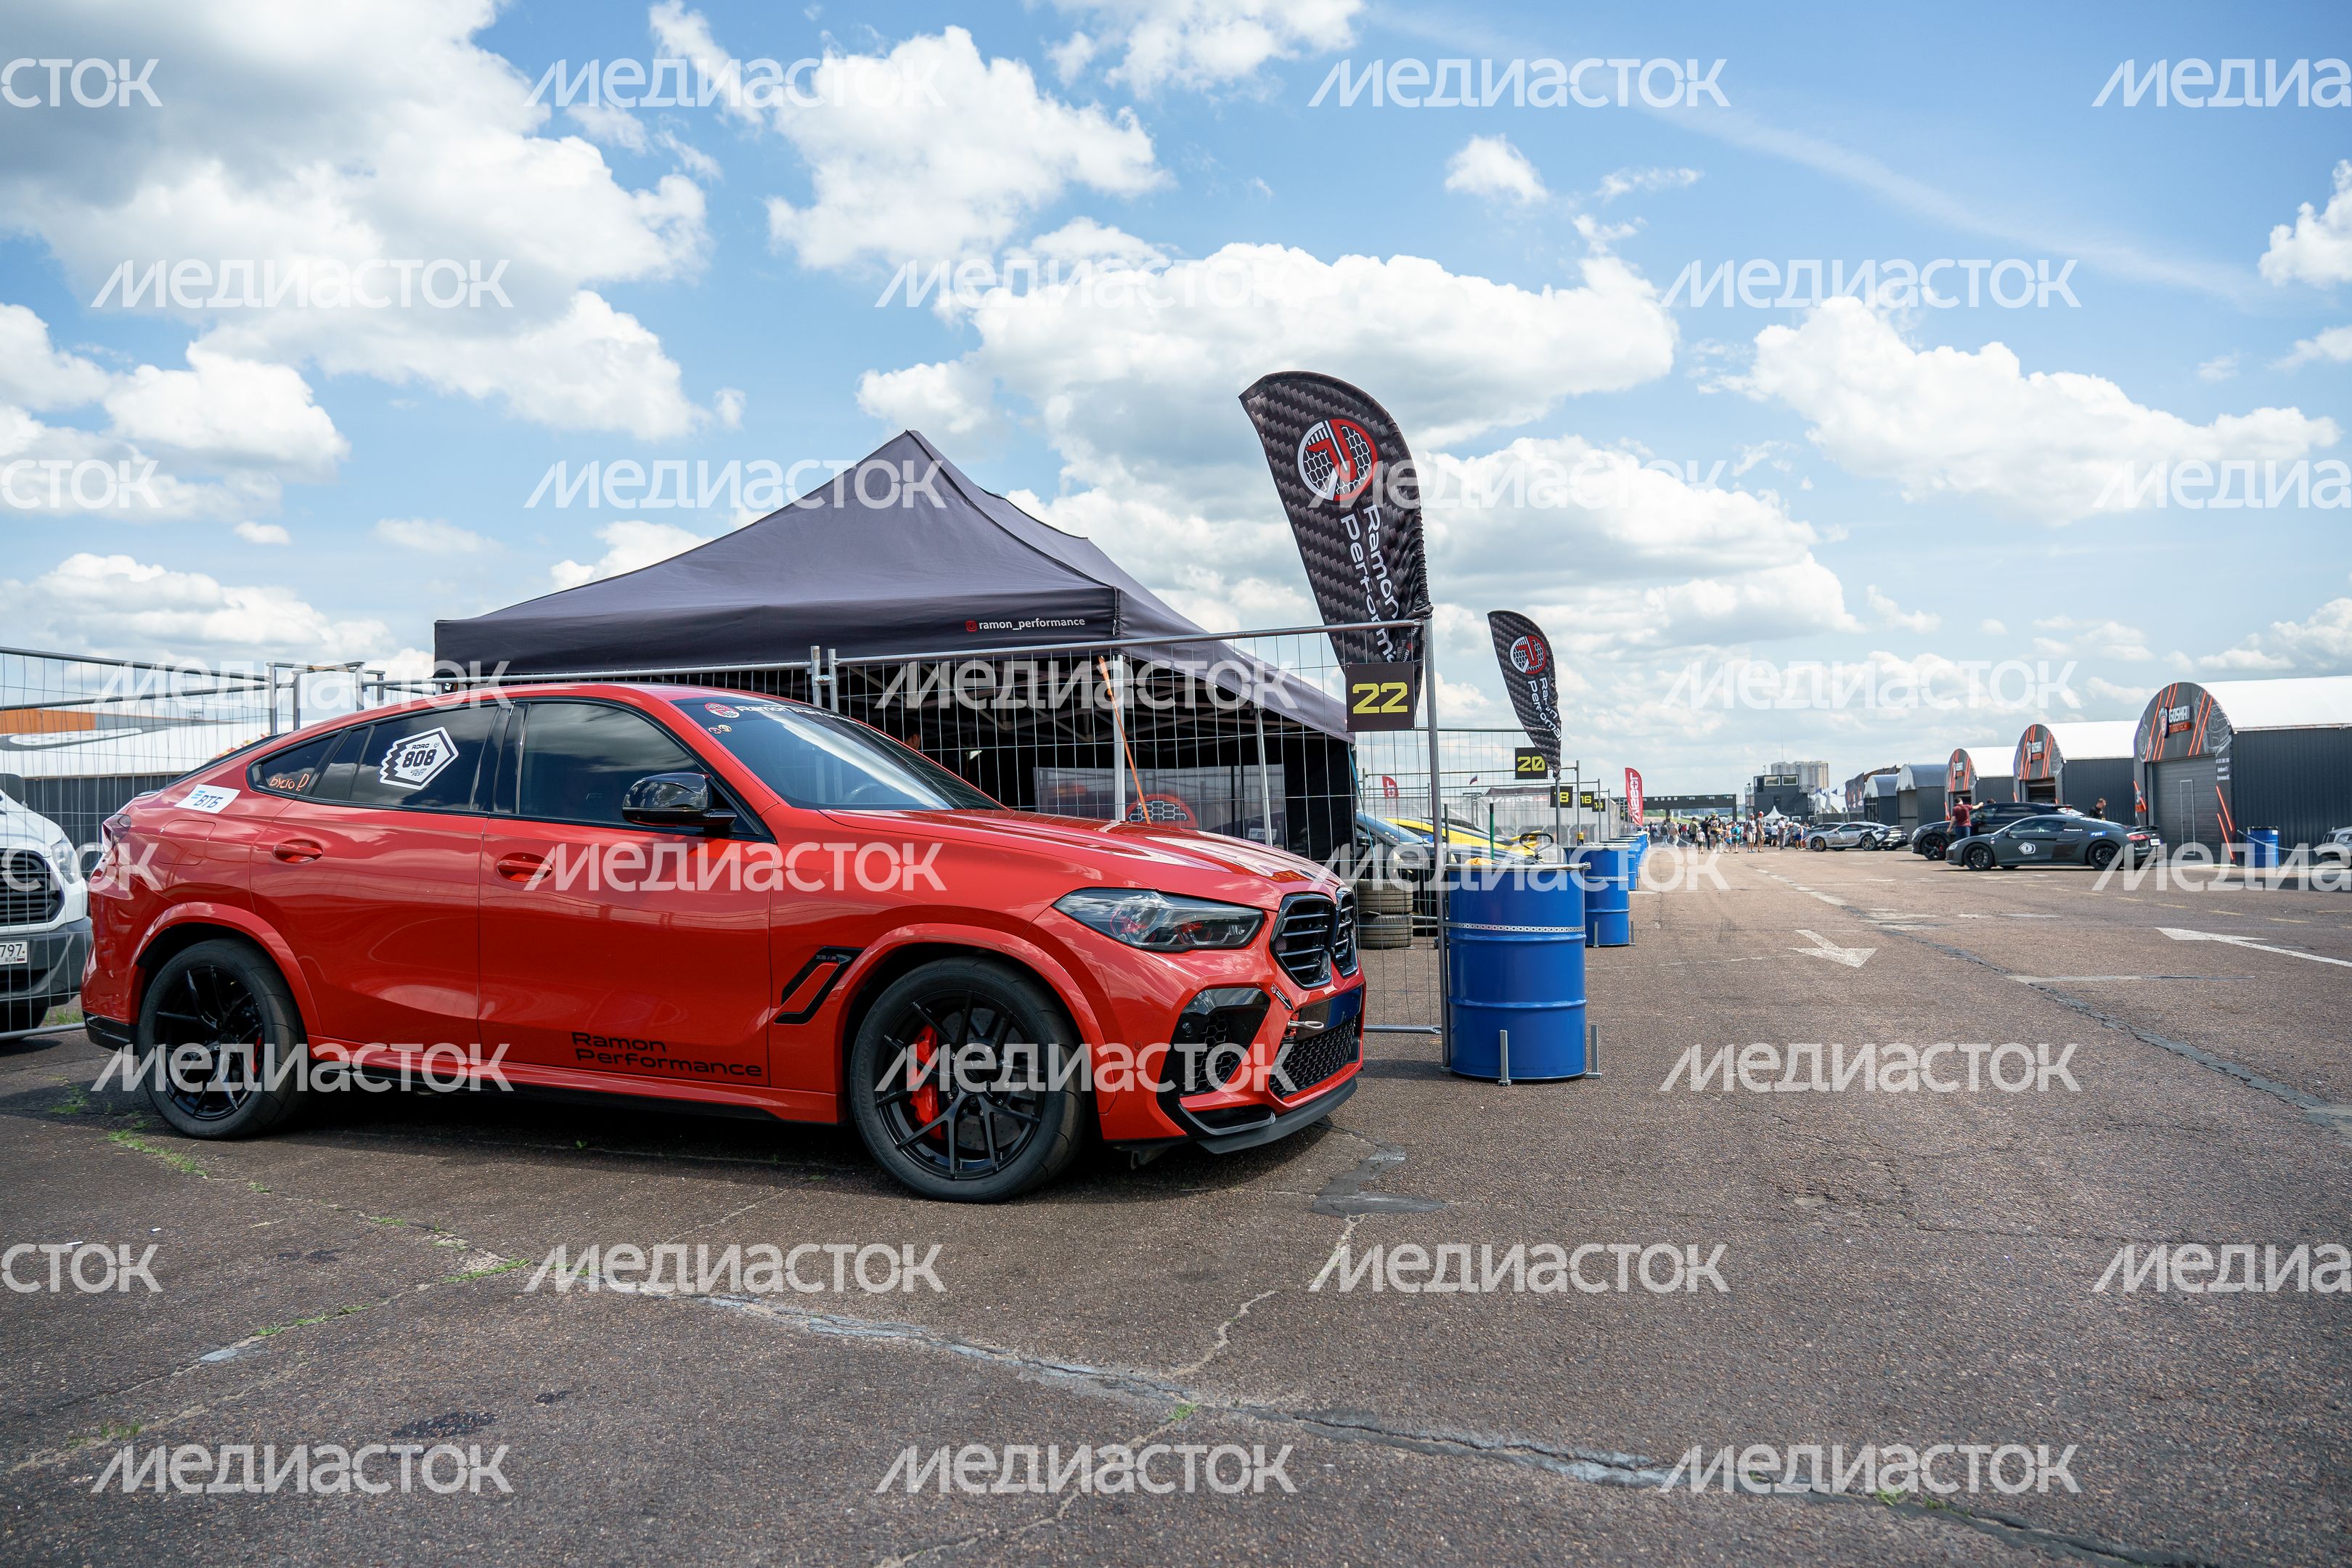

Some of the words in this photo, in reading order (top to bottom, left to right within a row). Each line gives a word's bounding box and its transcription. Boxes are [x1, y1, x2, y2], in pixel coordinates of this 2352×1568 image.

[1363, 505, 1399, 618] Ramon
[979, 618, 1085, 630] ramon_performance
[1352, 682, 1408, 714] 22
[2169, 706, 2189, 723] GOSHA
[402, 749, 437, 768] 808
[1517, 756, 1545, 772] 20
[193, 795, 224, 808] ВТБ
[1554, 791, 1569, 803] 8
[1580, 796, 1592, 804] 16
[0, 944, 23, 957] 797
[571, 1032, 666, 1053] Ramon
[575, 1048, 762, 1077] Performance
